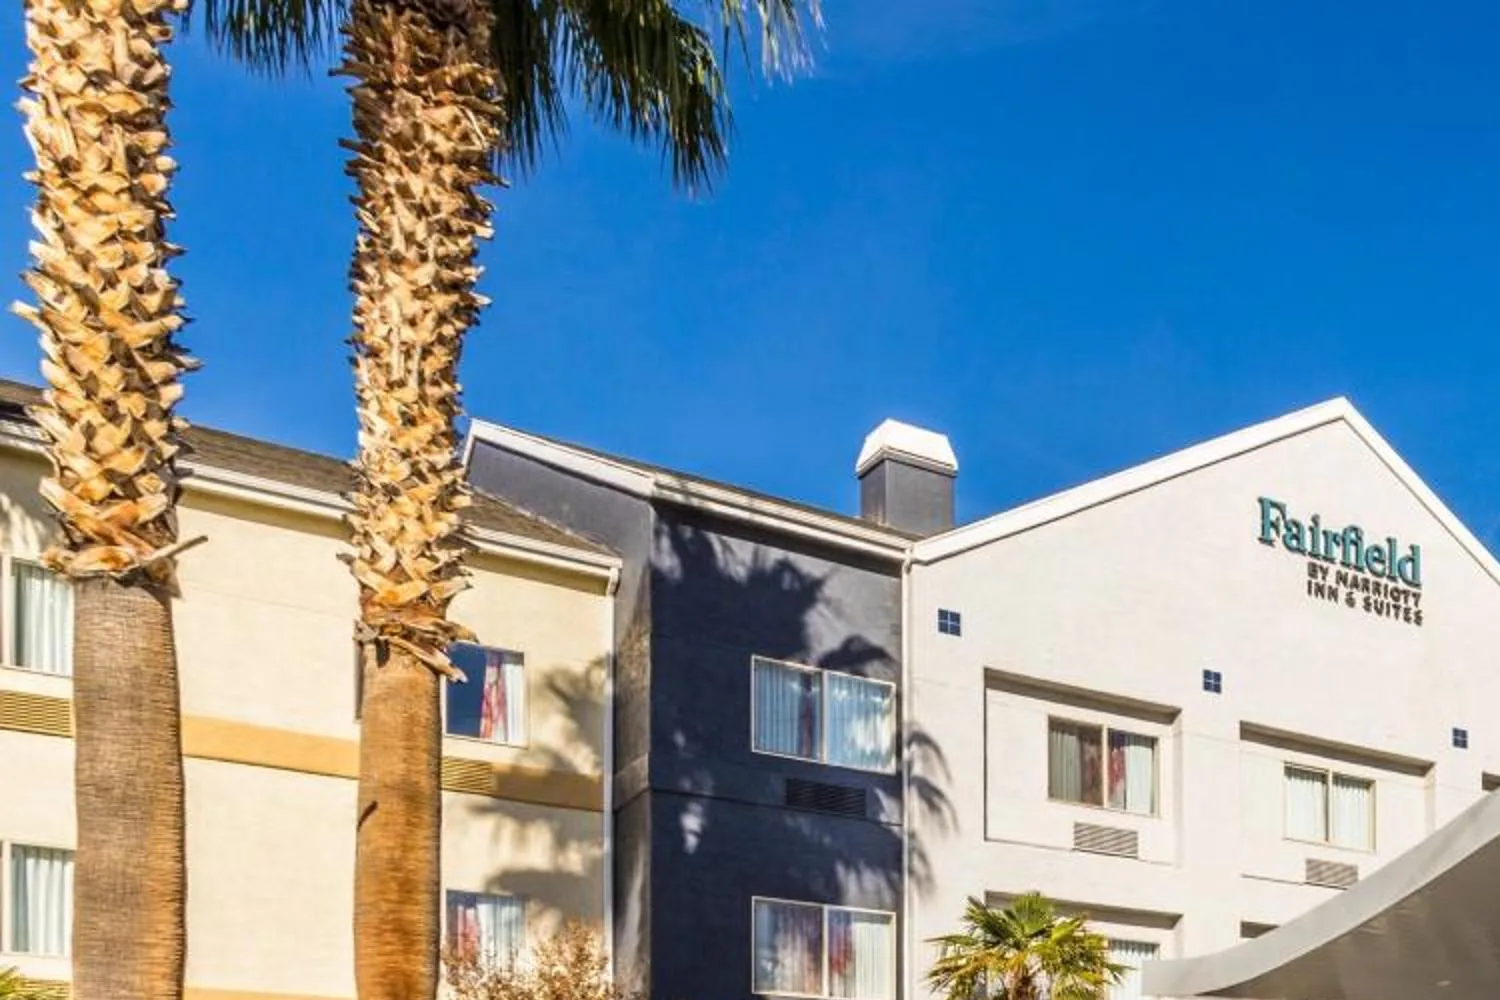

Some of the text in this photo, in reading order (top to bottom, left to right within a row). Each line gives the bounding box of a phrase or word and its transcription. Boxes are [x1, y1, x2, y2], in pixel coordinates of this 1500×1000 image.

[1257, 496, 1422, 590] Fairfield
[1307, 561, 1422, 608] BY MARRIOTT
[1307, 579, 1423, 627] INN & SUITES
